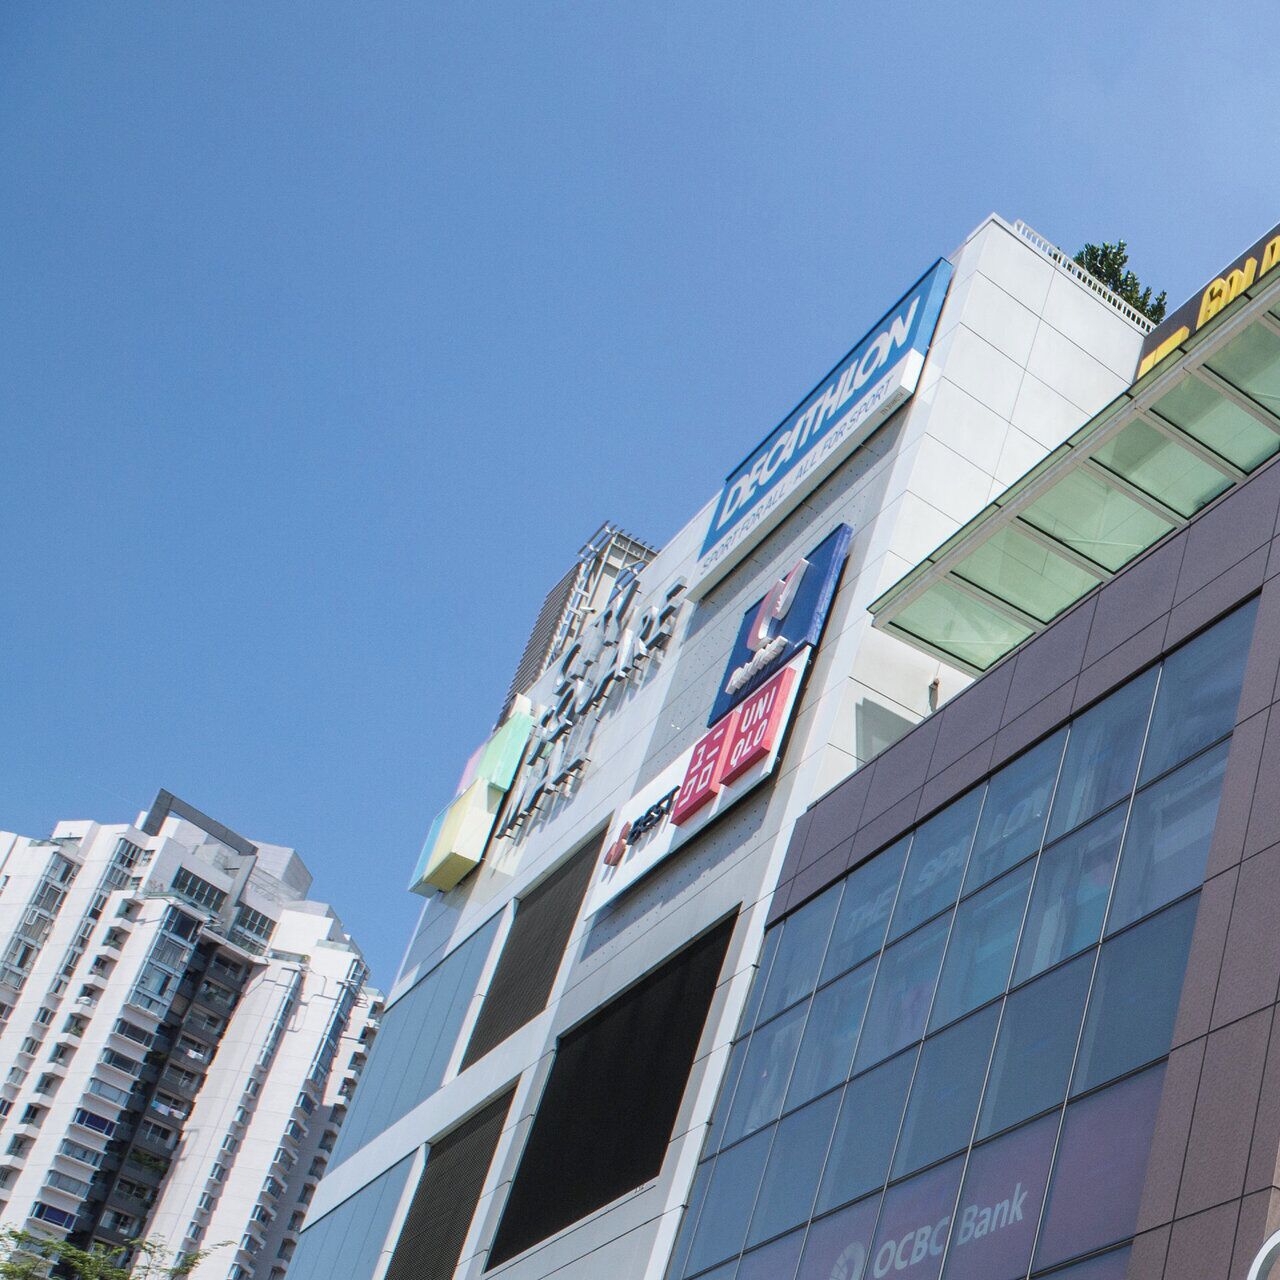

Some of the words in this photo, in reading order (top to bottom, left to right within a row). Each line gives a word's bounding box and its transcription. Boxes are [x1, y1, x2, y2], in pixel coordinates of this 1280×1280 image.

[716, 296, 921, 531] DECATHLON
[730, 718, 769, 768] QLO
[741, 686, 778, 733] UNI
[873, 1215, 951, 1280] OCBC
[956, 1182, 1029, 1247] Bank
